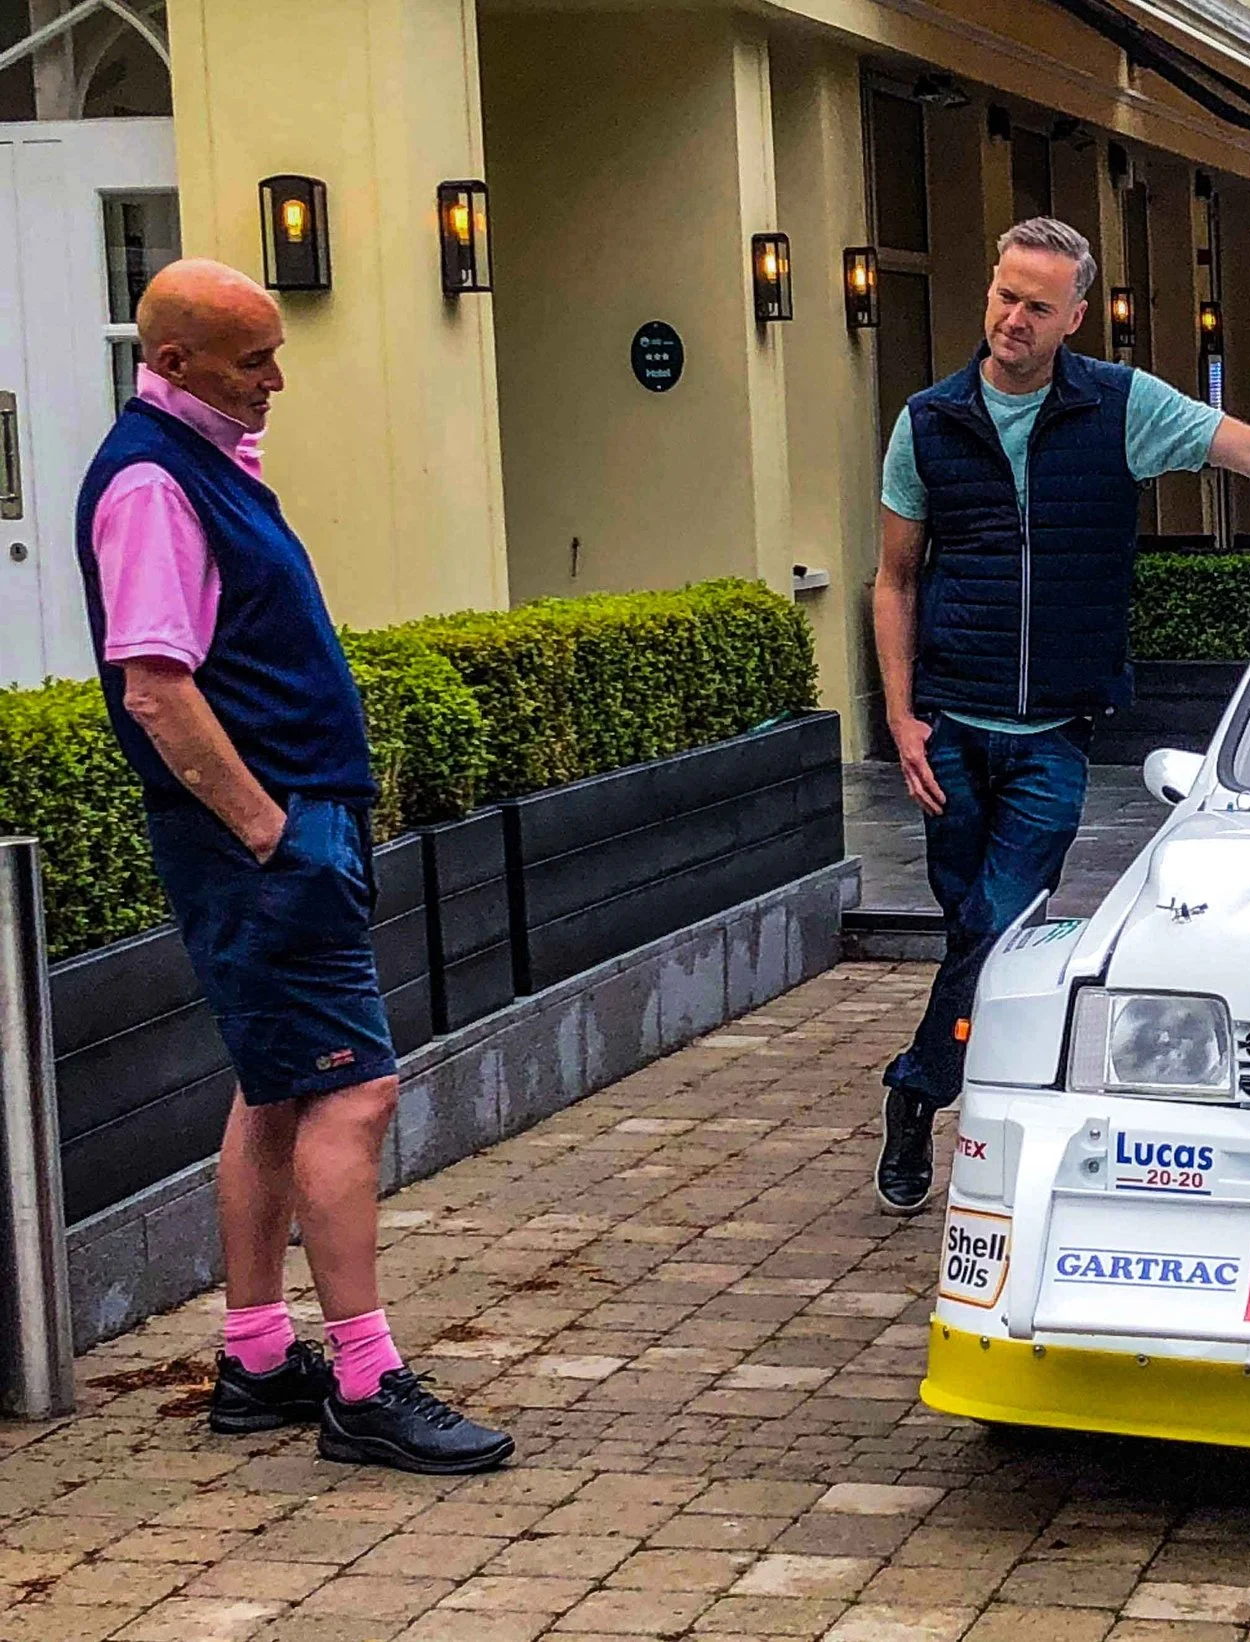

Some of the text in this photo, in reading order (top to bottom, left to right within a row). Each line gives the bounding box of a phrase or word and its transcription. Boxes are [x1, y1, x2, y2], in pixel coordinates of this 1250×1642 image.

[1115, 1131, 1214, 1170] Lucas
[1146, 1168, 1204, 1189] 20-20
[947, 1225, 1006, 1262] Shell
[947, 1254, 989, 1289] Oils
[1056, 1253, 1240, 1286] GARTRAC
